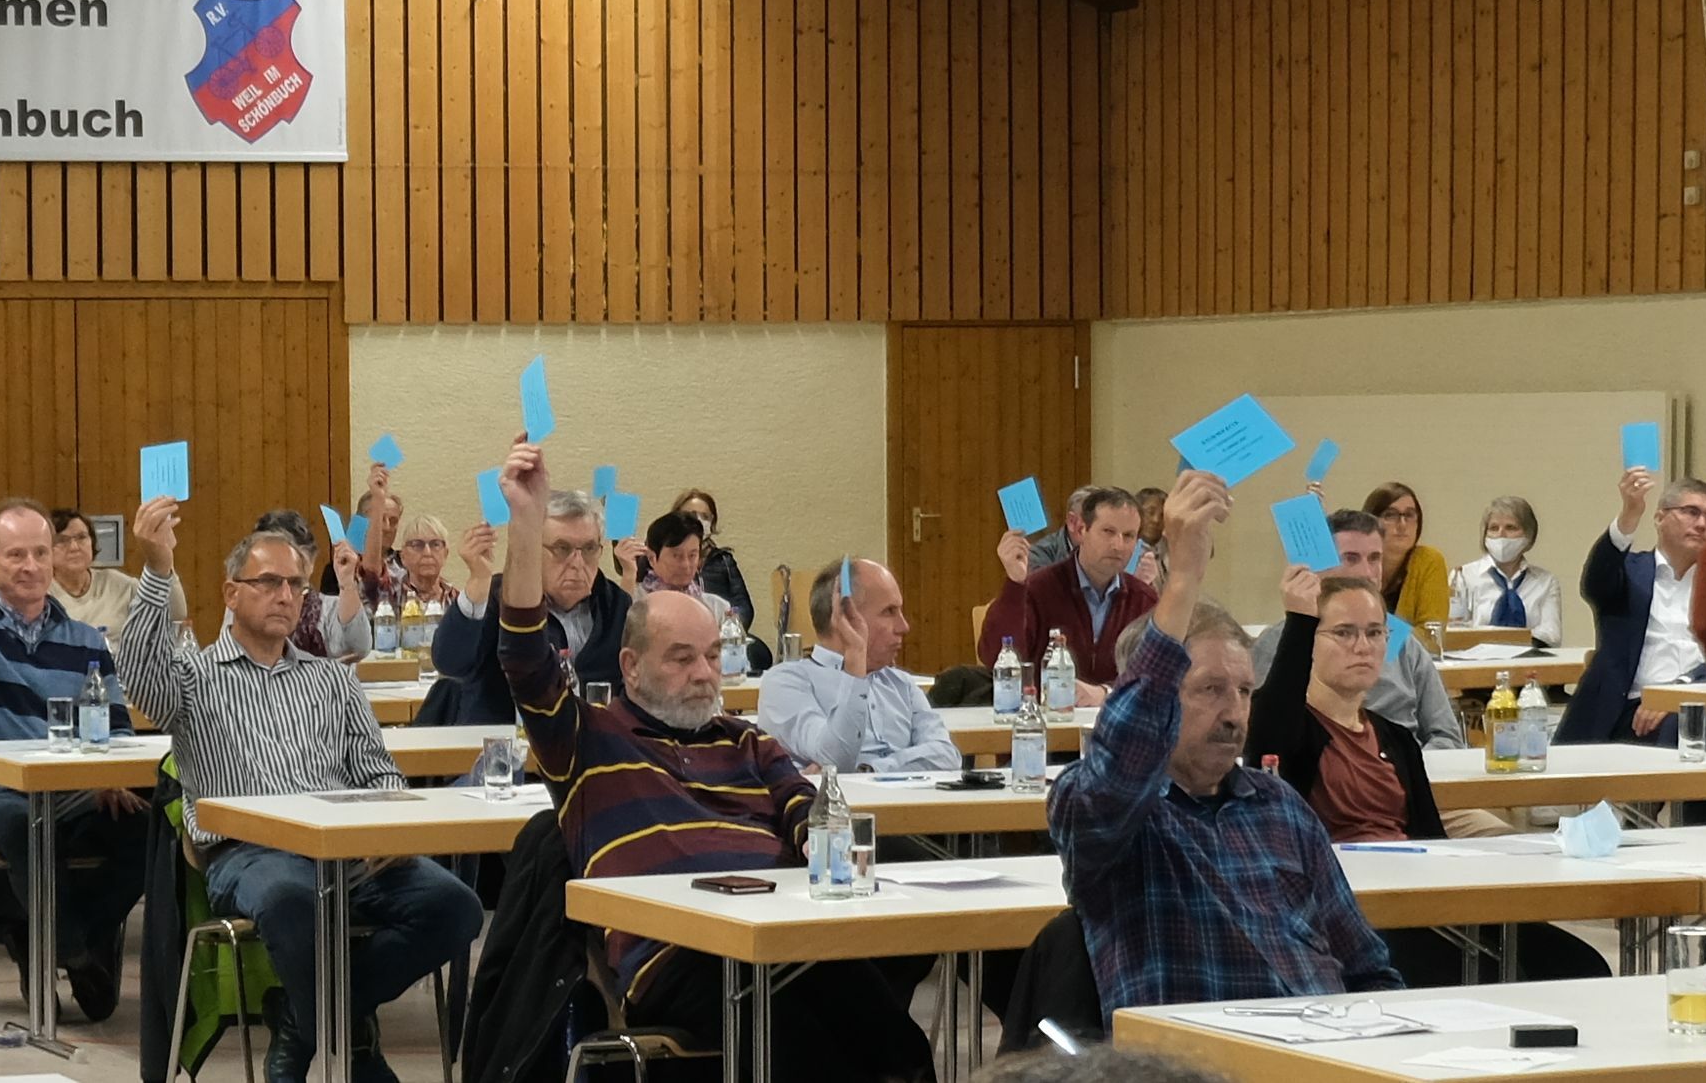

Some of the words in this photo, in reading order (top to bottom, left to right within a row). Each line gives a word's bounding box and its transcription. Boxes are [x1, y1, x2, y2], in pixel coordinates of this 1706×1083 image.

[205, 2, 229, 26] R.V.
[232, 83, 263, 111] WEIL
[263, 64, 281, 85] IM
